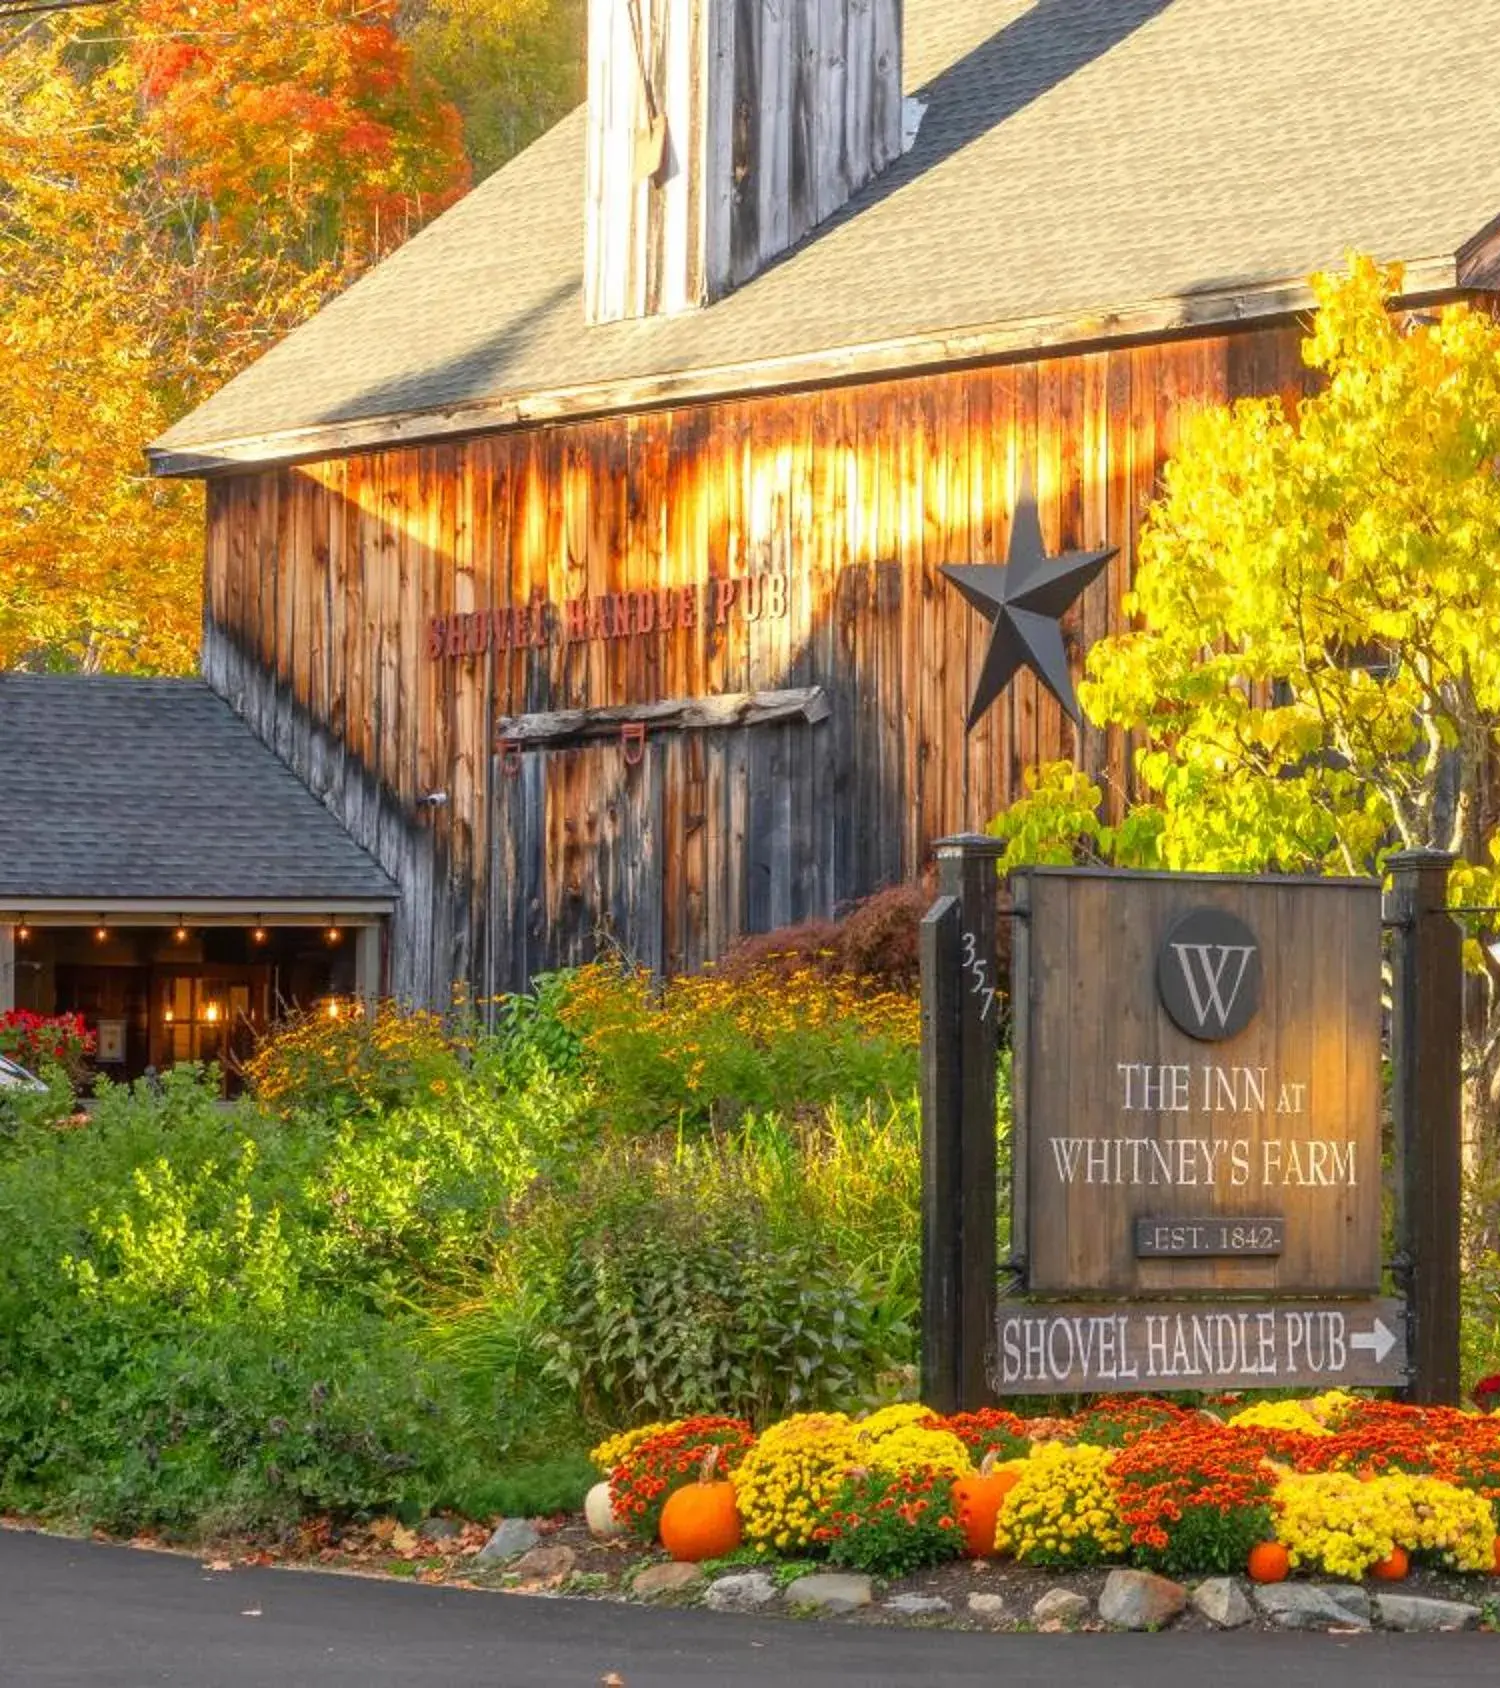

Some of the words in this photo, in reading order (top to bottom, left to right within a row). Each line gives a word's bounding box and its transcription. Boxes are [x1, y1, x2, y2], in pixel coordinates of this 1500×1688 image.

[427, 604, 549, 661] SHOVEL
[565, 586, 697, 642] HANDLE
[715, 572, 788, 625] PUB
[961, 932, 995, 1021] 357
[1170, 943, 1257, 1027] W
[1117, 1063, 1190, 1112] THE
[1201, 1066, 1267, 1113] INN
[1276, 1084, 1305, 1114] AT
[1049, 1137, 1250, 1186] WHITNEY'S
[1262, 1141, 1357, 1187] FARM
[1003, 1317, 1137, 1382] SHOVEL
[1146, 1311, 1277, 1376] HANDLE
[1285, 1310, 1346, 1371] PUB
